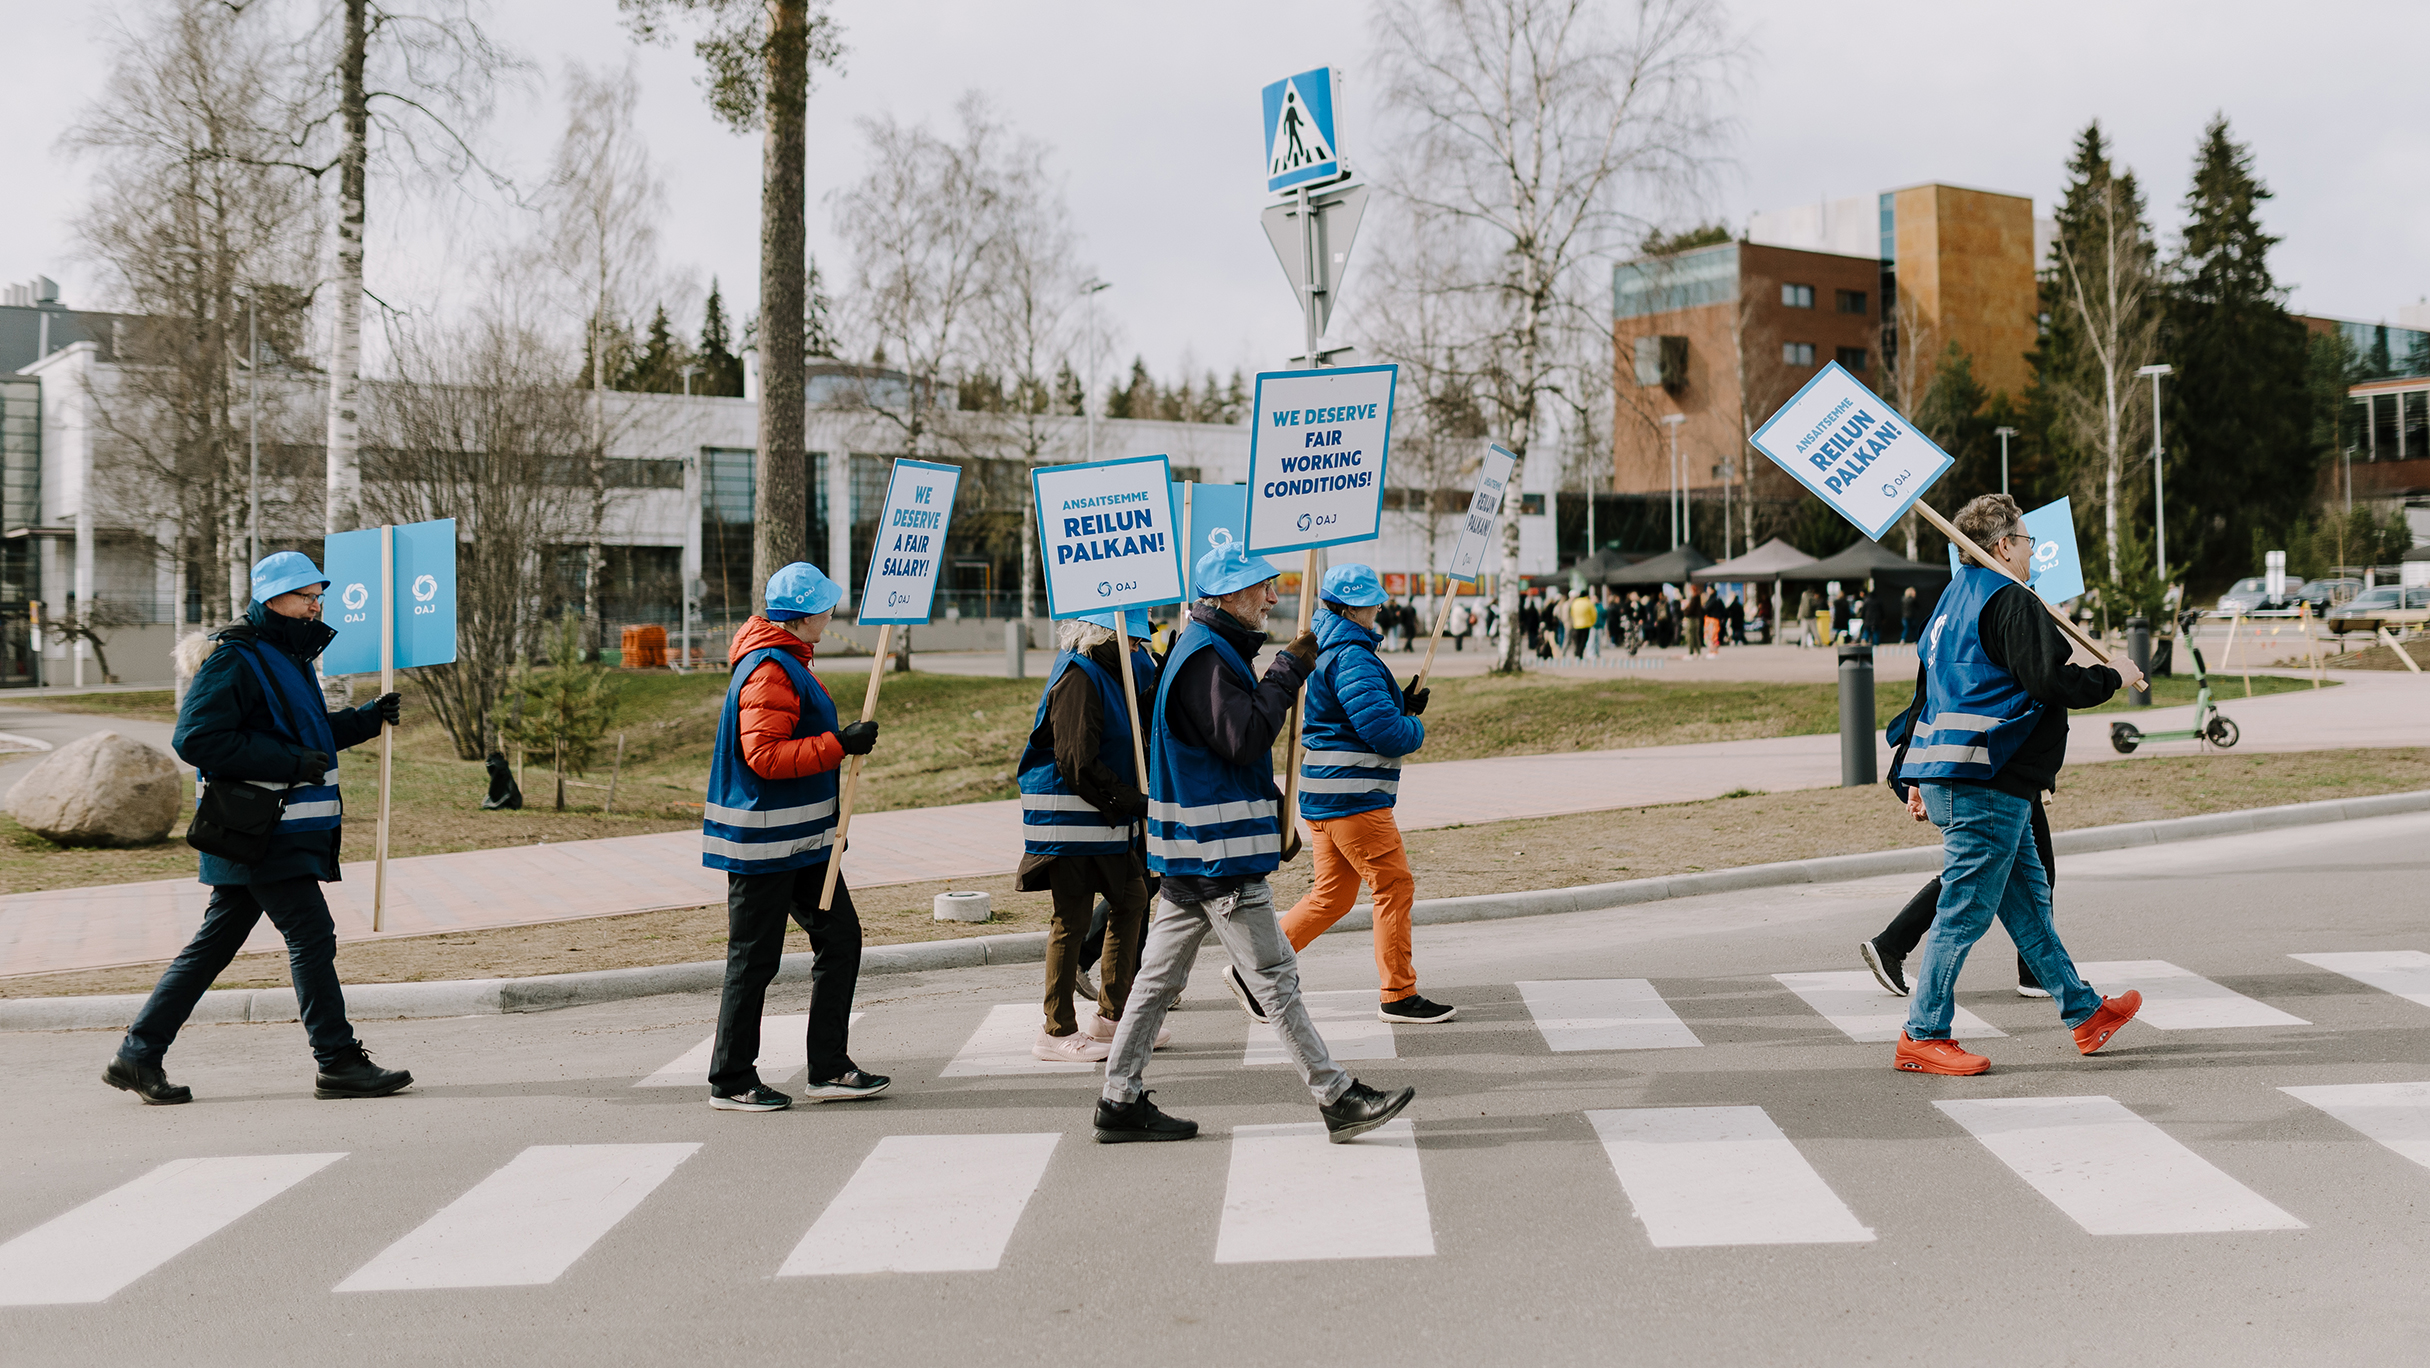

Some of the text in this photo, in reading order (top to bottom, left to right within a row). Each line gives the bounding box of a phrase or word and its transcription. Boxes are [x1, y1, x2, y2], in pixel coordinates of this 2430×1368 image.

[1272, 403, 1377, 427] WE DESERVE
[1795, 397, 1854, 454] ANSAITSEMME
[1305, 430, 1342, 448] FAIR
[1808, 409, 1876, 472] REILUN
[1281, 450, 1362, 473] WORKING
[1824, 420, 1902, 495] PALKAN!
[1263, 471, 1372, 499] CONDITIONS!
[1894, 469, 1911, 486] OAJ
[915, 485, 933, 504] WE
[1062, 491, 1149, 511] ANSAITSEMME
[893, 508, 941, 529] DESERVE
[1063, 508, 1153, 538] REILUN
[1316, 513, 1337, 526] OAJ
[893, 533, 929, 553] A FAIR
[1057, 532, 1165, 565] PALKAN!
[882, 558, 930, 577] SALARY!
[2039, 559, 2059, 572] OAJ
[1115, 581, 1137, 592] OAJ
[897, 594, 911, 604] OAJ
[344, 612, 366, 623] OAJ
[414, 604, 436, 615] OAJ
